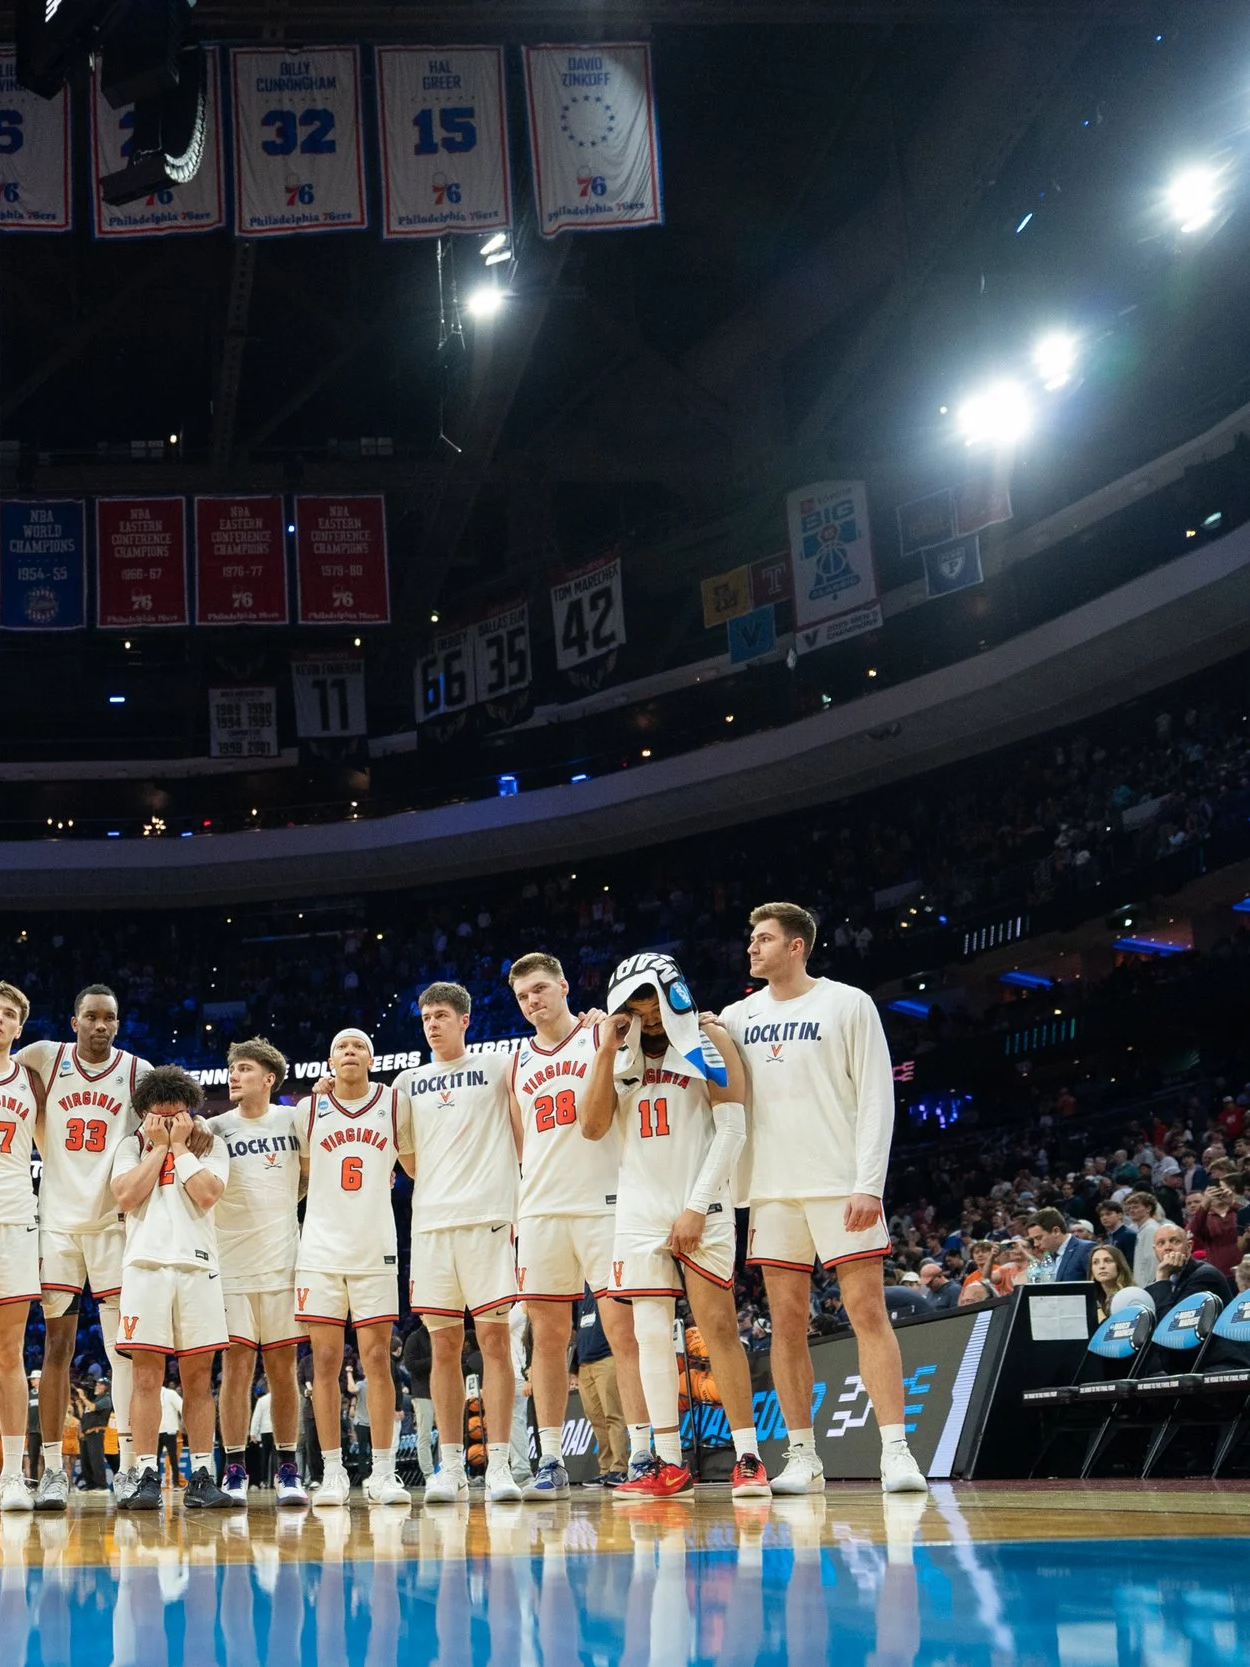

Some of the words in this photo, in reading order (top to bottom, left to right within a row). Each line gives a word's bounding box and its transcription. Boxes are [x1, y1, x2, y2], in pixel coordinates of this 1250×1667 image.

[281, 61, 311, 77] BILLY
[428, 60, 453, 73] HAL
[568, 57, 603, 71] DAVID
[257, 76, 337, 92] CUNNINGHAM
[422, 74, 461, 90] GREER
[561, 72, 611, 87] ZINKOFF
[261, 108, 337, 156] 32
[412, 107, 477, 156] 15
[285, 183, 314, 206] 76
[432, 183, 461, 205] 76
[577, 176, 607, 197] 76
[110, 213, 178, 227] Philadelphia
[250, 214, 320, 228] Philadelphia
[398, 213, 466, 226] Philadelphia
[30, 509, 54, 523] NBA
[130, 508, 152, 521] NBA
[230, 506, 251, 518] NBA
[329, 505, 350, 517] NBA
[22, 525, 62, 538] WORLD
[120, 520, 163, 532] EASTERN
[220, 519, 263, 530] EASTERN
[318, 518, 362, 529] EASTERN
[111, 532, 172, 545] CONFERENCE
[211, 530, 271, 543] CONFERENCE
[311, 530, 370, 543] CONFERENCE
[9, 538, 75, 554] CHAMPIONS
[114, 546, 170, 558] CHAMPIONS
[214, 543, 270, 555] CHAMPIONS
[313, 542, 369, 555] CHAMPIONS
[131, 593, 153, 611] 76
[232, 591, 253, 609] 76
[332, 591, 354, 609] 76
[561, 594, 617, 657] 42
[310, 678, 350, 732] 11
[744, 1024, 781, 1045] LOCK
[782, 1023, 798, 1042] IT
[798, 1021, 823, 1041] IN.
[411, 1073, 447, 1097] LOCK
[448, 1071, 465, 1091] IT
[464, 1069, 489, 1089] IN.
[523, 1059, 587, 1095] VIRGINIA
[57, 1091, 123, 1117] VIRGINIA
[534, 1088, 578, 1134] 28
[638, 1098, 670, 1139] 11
[64, 1118, 108, 1153] 33
[319, 1128, 389, 1153] VIRGINIA
[227, 1138, 271, 1158] LOCK
[272, 1136, 287, 1151] IT
[158, 1151, 176, 1187] 2
[340, 1156, 364, 1192] 6
